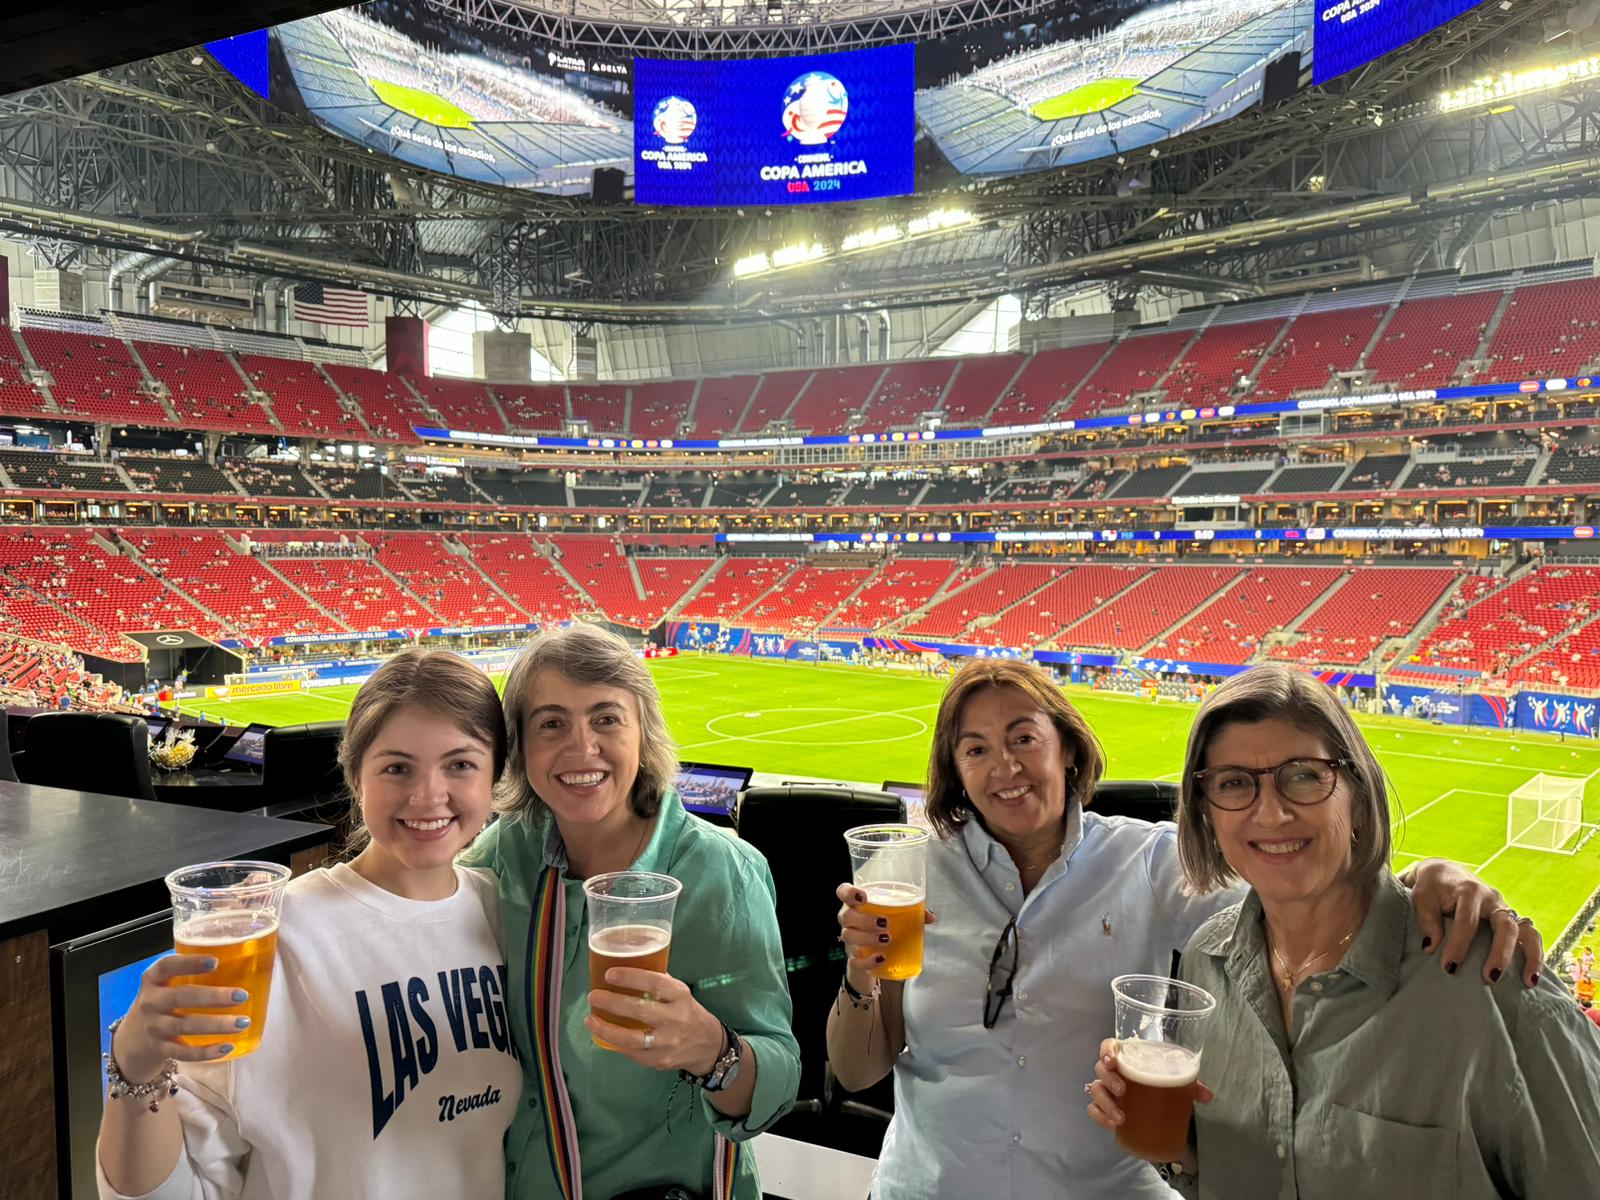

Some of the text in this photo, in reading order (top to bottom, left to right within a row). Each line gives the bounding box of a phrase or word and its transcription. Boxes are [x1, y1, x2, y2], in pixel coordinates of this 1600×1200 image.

[557, 56, 586, 67] LATAM
[600, 63, 628, 74] DELTA
[1095, 122, 1108, 134] de
[1107, 119, 1122, 131] los
[444, 141, 457, 153] los
[641, 150, 666, 160] COPA
[760, 160, 867, 180] COPA AMERICA
[786, 179, 841, 193] USA 2024
[232, 681, 293, 695] mercado libre
[355, 976, 439, 1141] LAS
[438, 1084, 502, 1122] Nevada
